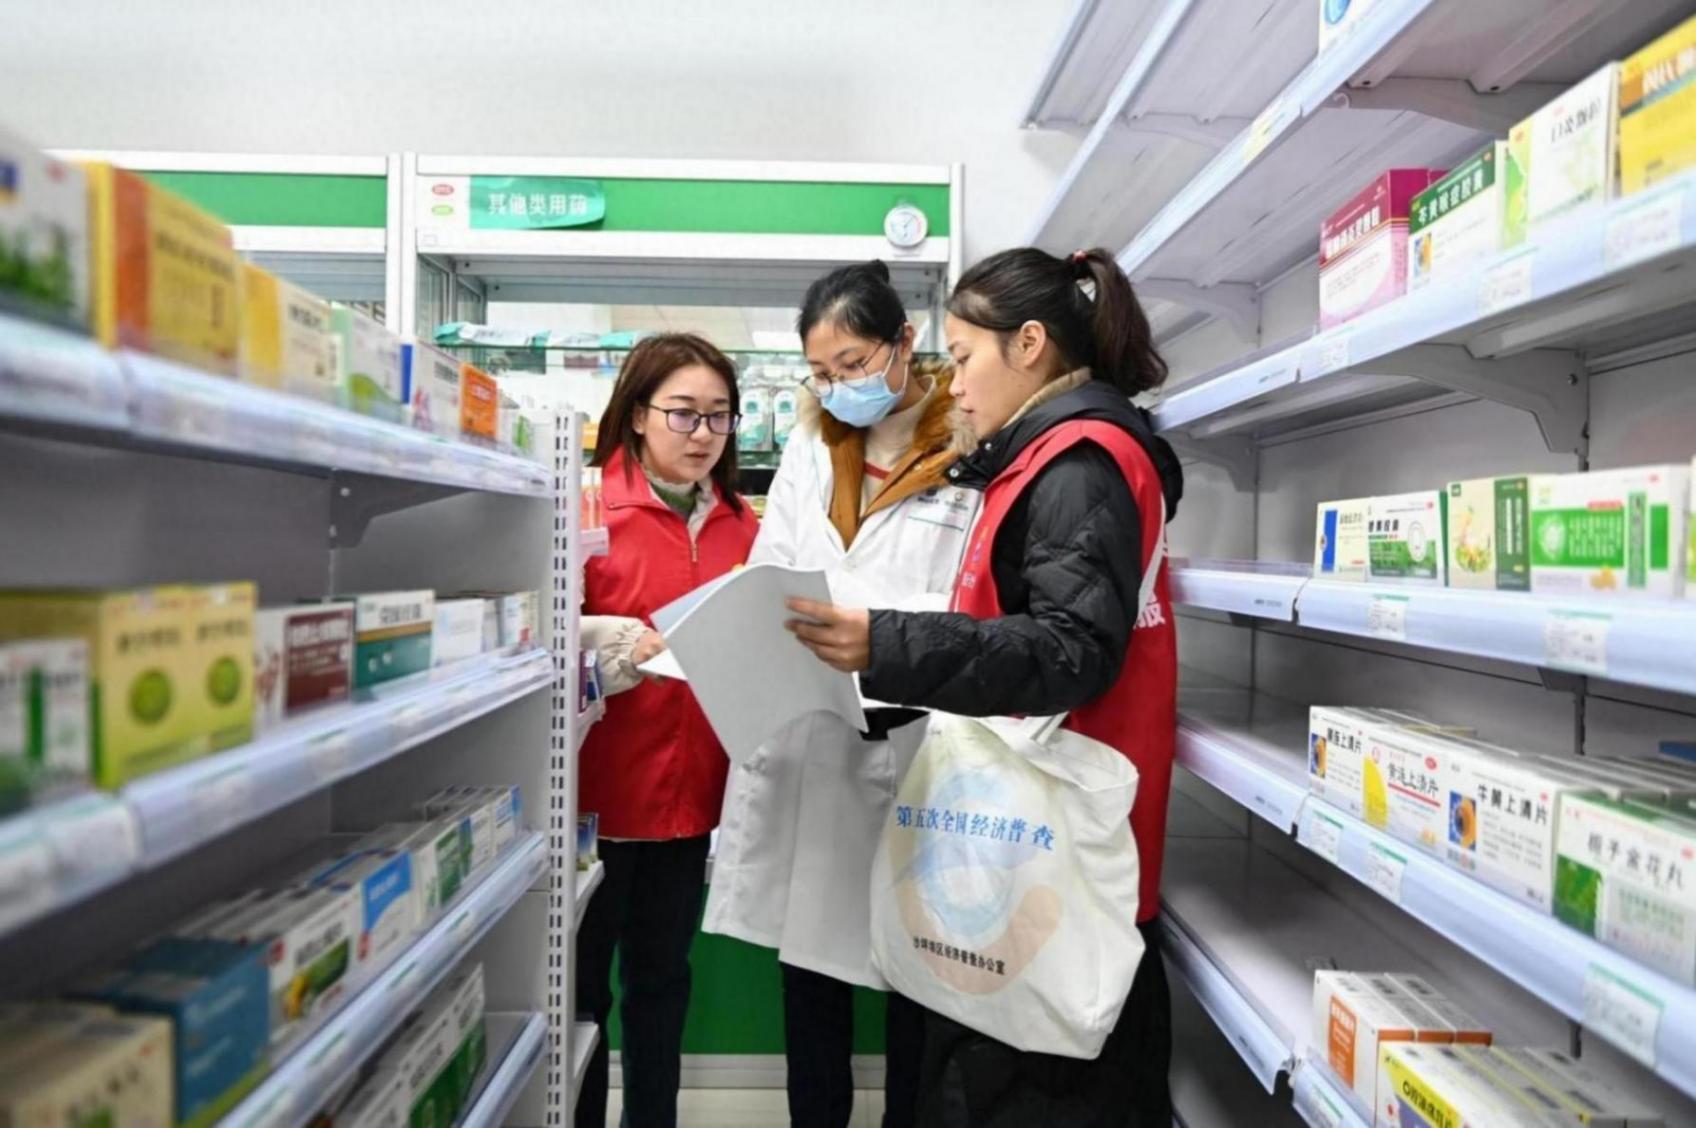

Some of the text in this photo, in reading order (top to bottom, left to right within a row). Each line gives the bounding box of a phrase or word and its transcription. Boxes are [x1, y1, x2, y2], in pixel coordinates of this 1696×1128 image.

[896, 806, 1055, 851] 第五次全国经济普查
